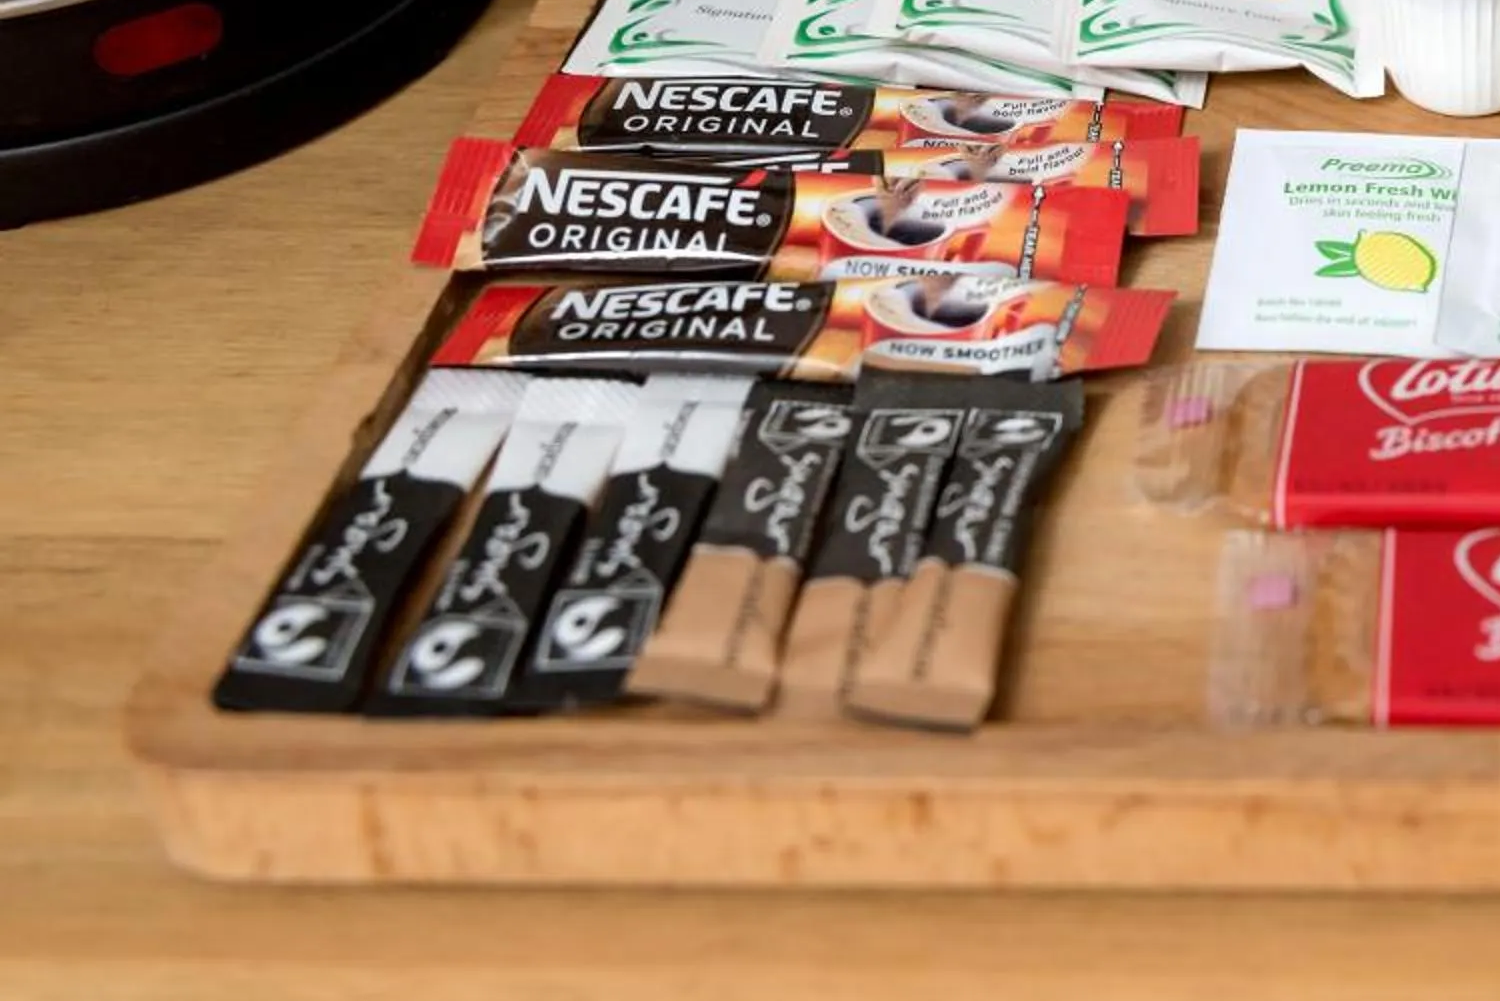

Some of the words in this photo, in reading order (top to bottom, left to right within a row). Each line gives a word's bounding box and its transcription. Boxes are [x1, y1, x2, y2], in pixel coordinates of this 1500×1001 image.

[623, 115, 820, 139] ORIGINAL
[1320, 157, 1424, 175] Preema
[1283, 182, 1358, 195] Lemon
[1365, 182, 1423, 198] Fresh
[1430, 187, 1458, 201] Wi
[845, 261, 890, 276] NOW
[558, 317, 775, 342] ORIGINAL
[889, 341, 935, 357] NOW
